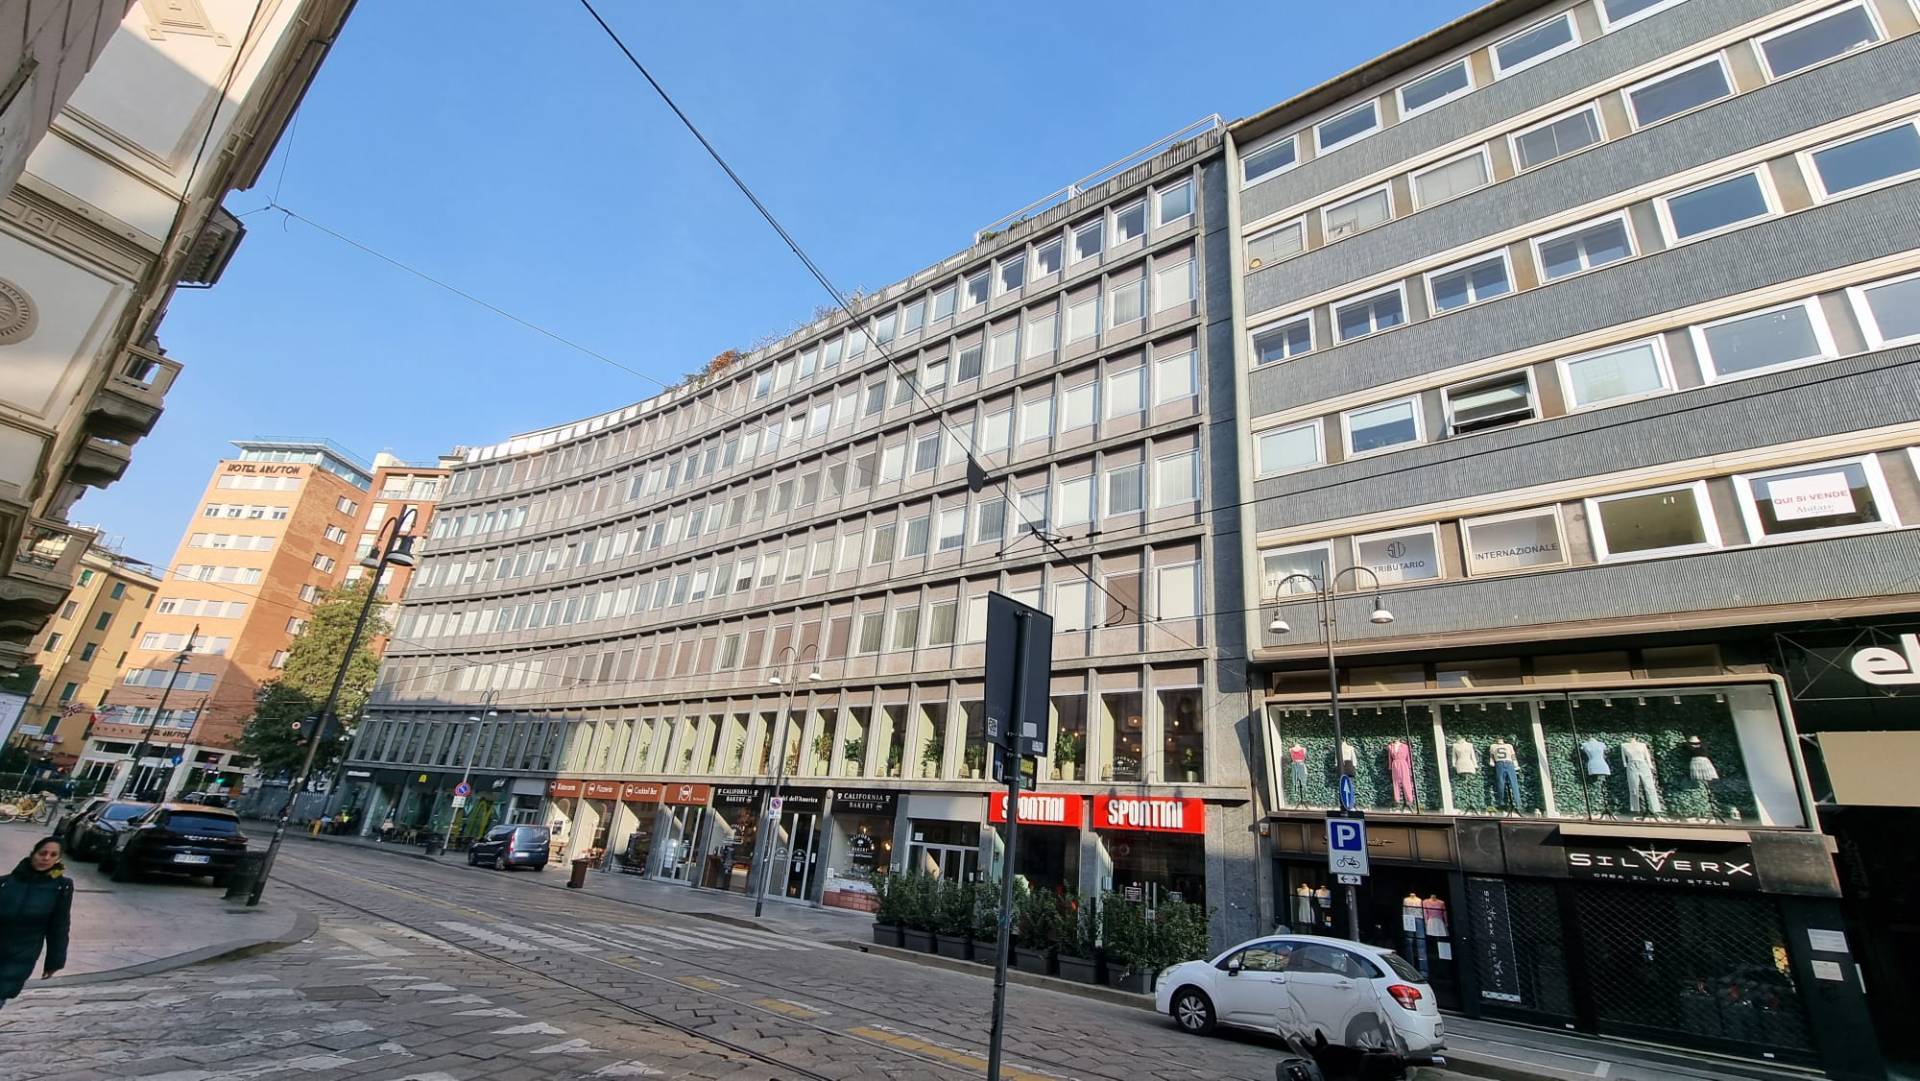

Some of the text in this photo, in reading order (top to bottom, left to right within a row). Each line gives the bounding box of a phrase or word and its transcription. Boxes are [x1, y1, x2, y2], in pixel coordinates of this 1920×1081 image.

[227, 464, 301, 474] HOTEL ARISTON
[1774, 490, 1848, 505] QUI SI VENDE
[1475, 542, 1558, 561] INTERNAZIONALE
[1373, 560, 1425, 574] TRIBUTARIO
[843, 792, 883, 801] CALIFORNIA
[849, 801, 873, 809] BAKERY
[1108, 799, 1184, 828] SPONTINI
[1337, 824, 1356, 848] P
[1688, 879, 1730, 888] STILE
